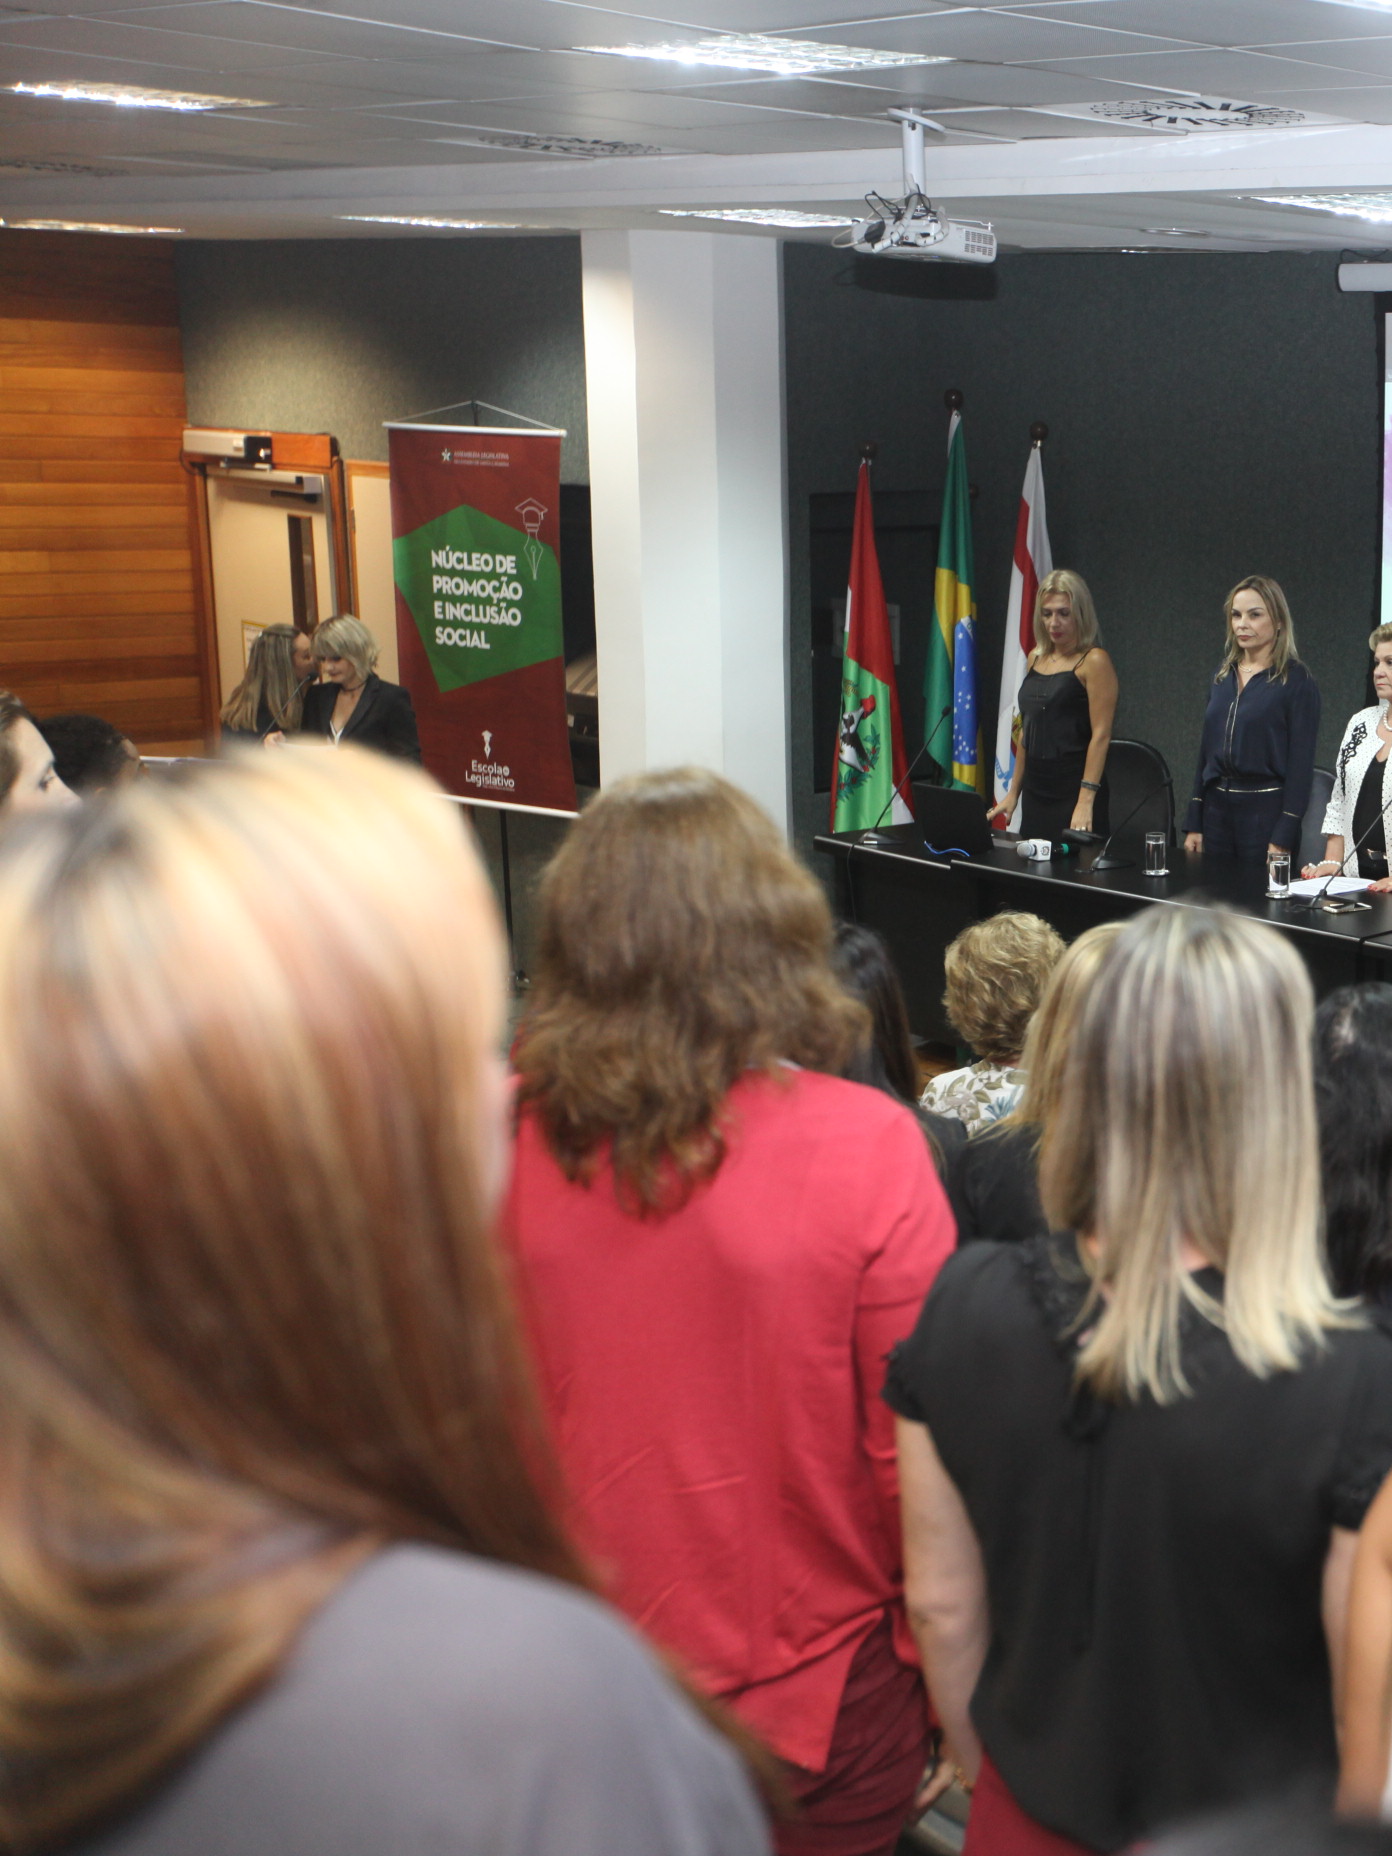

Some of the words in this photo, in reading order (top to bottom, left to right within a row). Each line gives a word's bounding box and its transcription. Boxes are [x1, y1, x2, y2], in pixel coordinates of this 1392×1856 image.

[431, 545, 494, 572] NÚCLEO
[495, 554, 517, 574] DE
[432, 574, 523, 604] PROMOÇÃO
[434, 600, 444, 619] E
[445, 601, 522, 627] INCLUSÃO
[435, 626, 491, 649] SOCIAL
[465, 770, 515, 788] Legislativo
[471, 759, 502, 775] Escola
